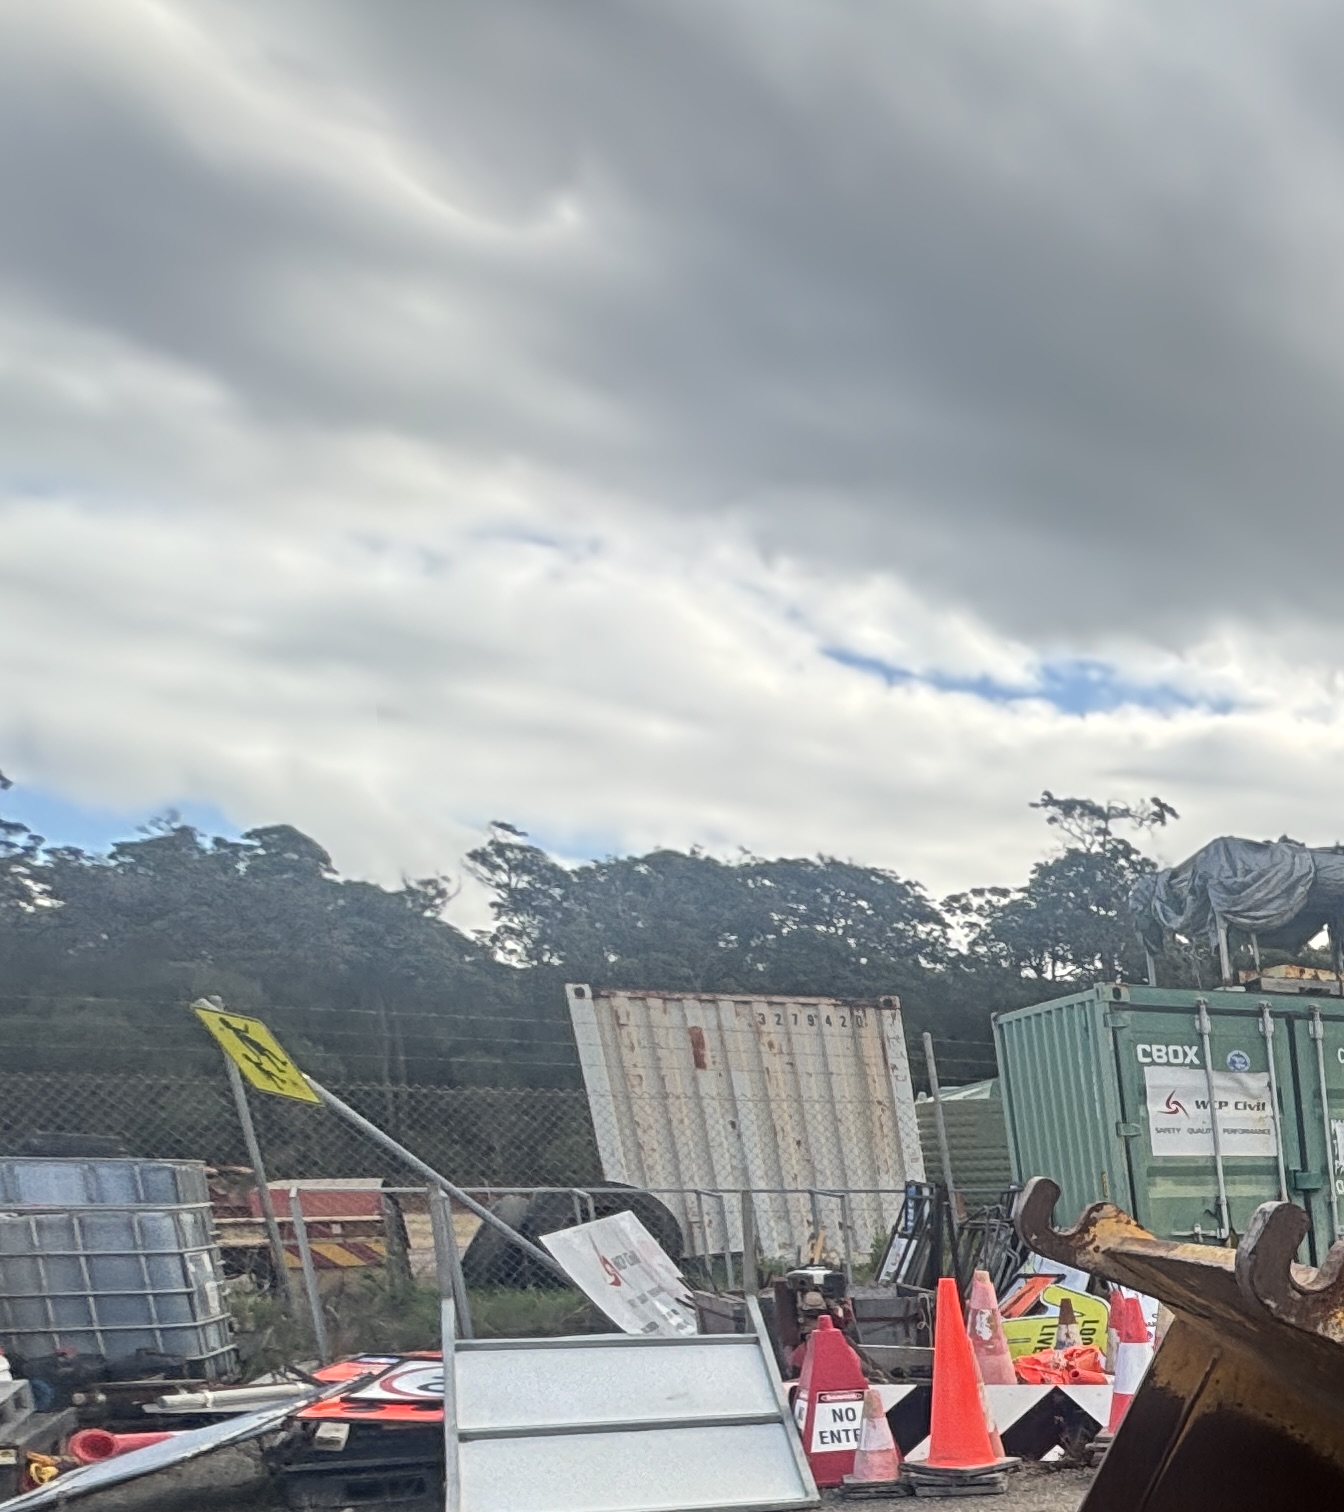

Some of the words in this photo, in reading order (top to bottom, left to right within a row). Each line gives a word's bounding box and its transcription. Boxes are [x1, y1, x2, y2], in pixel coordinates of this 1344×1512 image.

[1136, 1044, 1201, 1065] CBOX
[1234, 1100, 1267, 1112] Civil
[1187, 1127, 1214, 1135] QUALIT
[831, 1407, 857, 1423] NO
